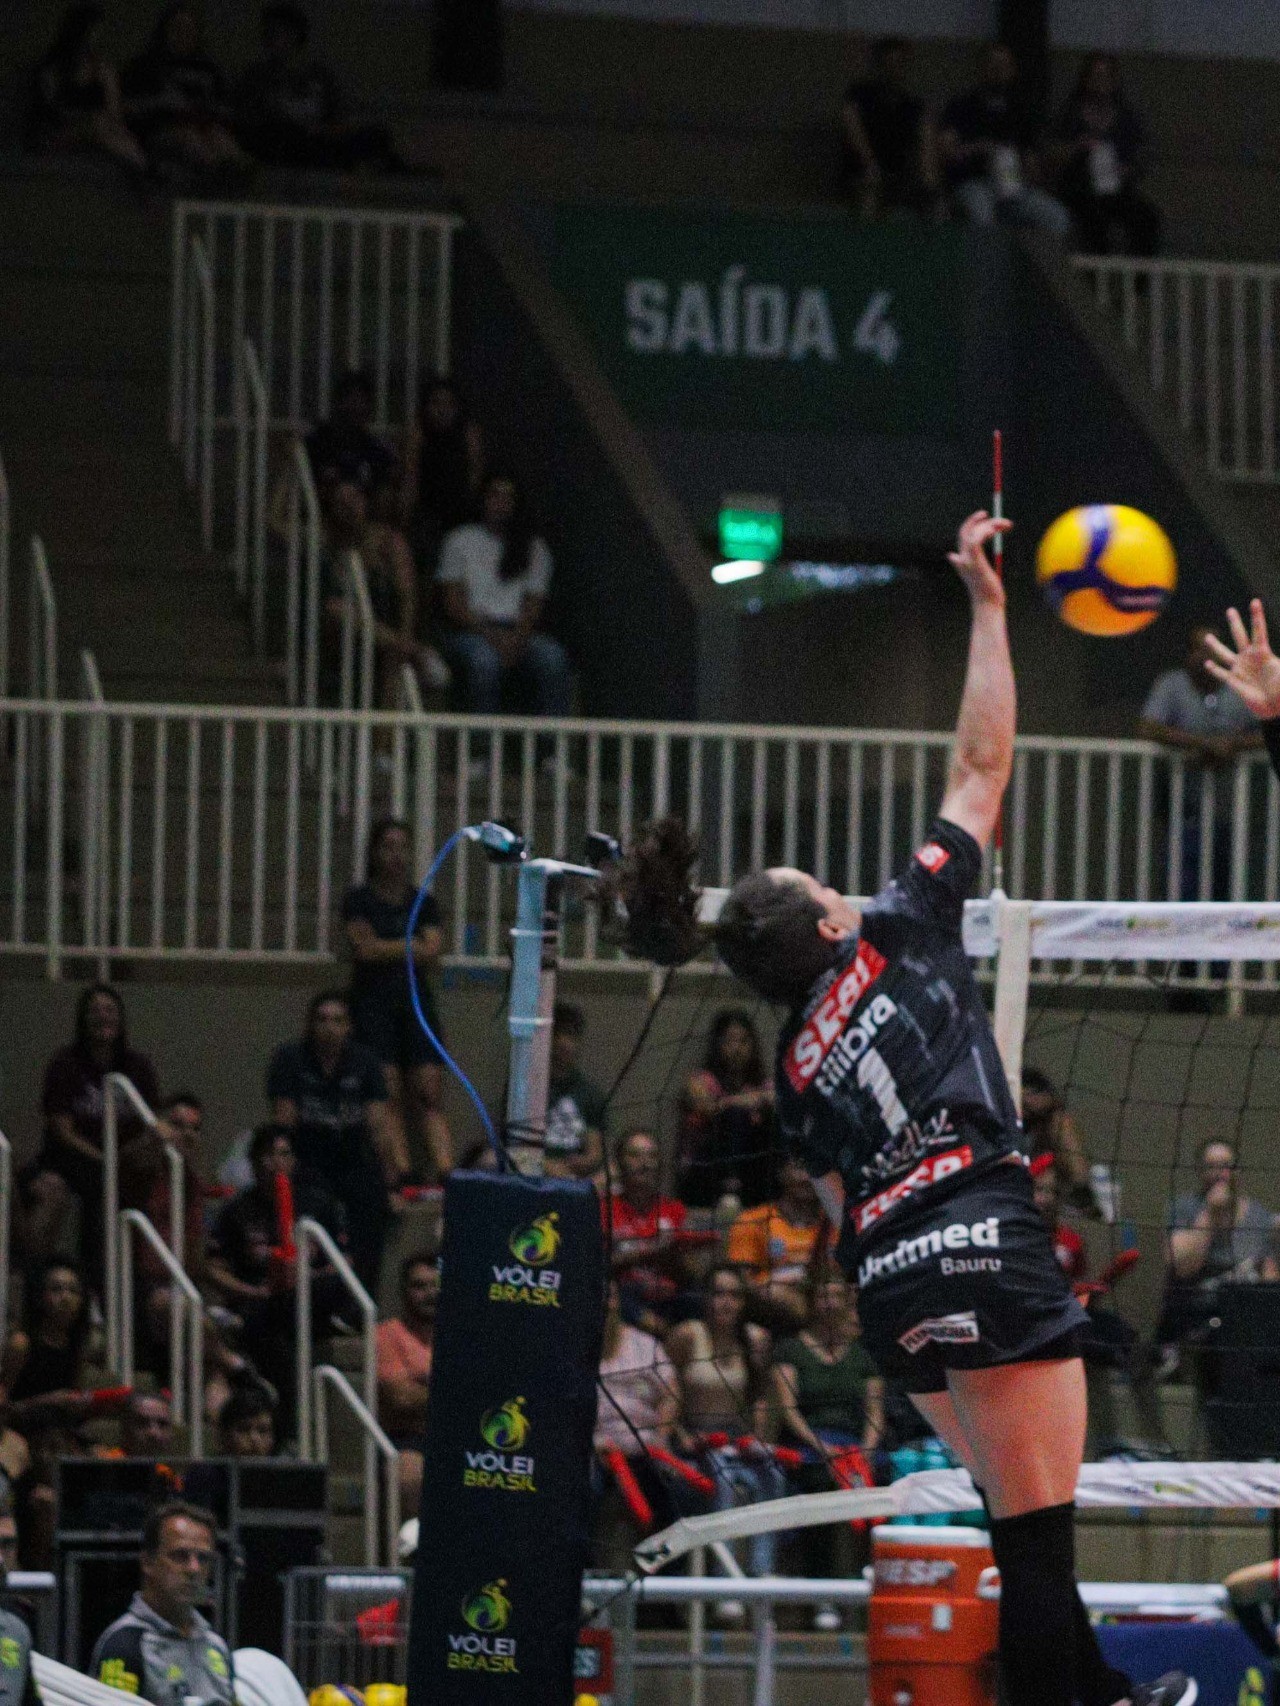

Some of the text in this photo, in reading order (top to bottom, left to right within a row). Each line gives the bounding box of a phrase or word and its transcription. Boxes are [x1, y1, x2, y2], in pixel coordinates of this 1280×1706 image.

[624, 264, 899, 364] SAÍDA 4
[814, 993, 897, 1096] tilibra
[857, 1047, 908, 1136] 1
[940, 1256, 1001, 1275] Bauru
[488, 1282, 561, 1308] BRASIL
[464, 1450, 536, 1476] VÔLEI
[463, 1468, 538, 1493] BRASIL
[448, 1631, 517, 1657] VÔLEI
[447, 1653, 520, 1674] BRASIL
